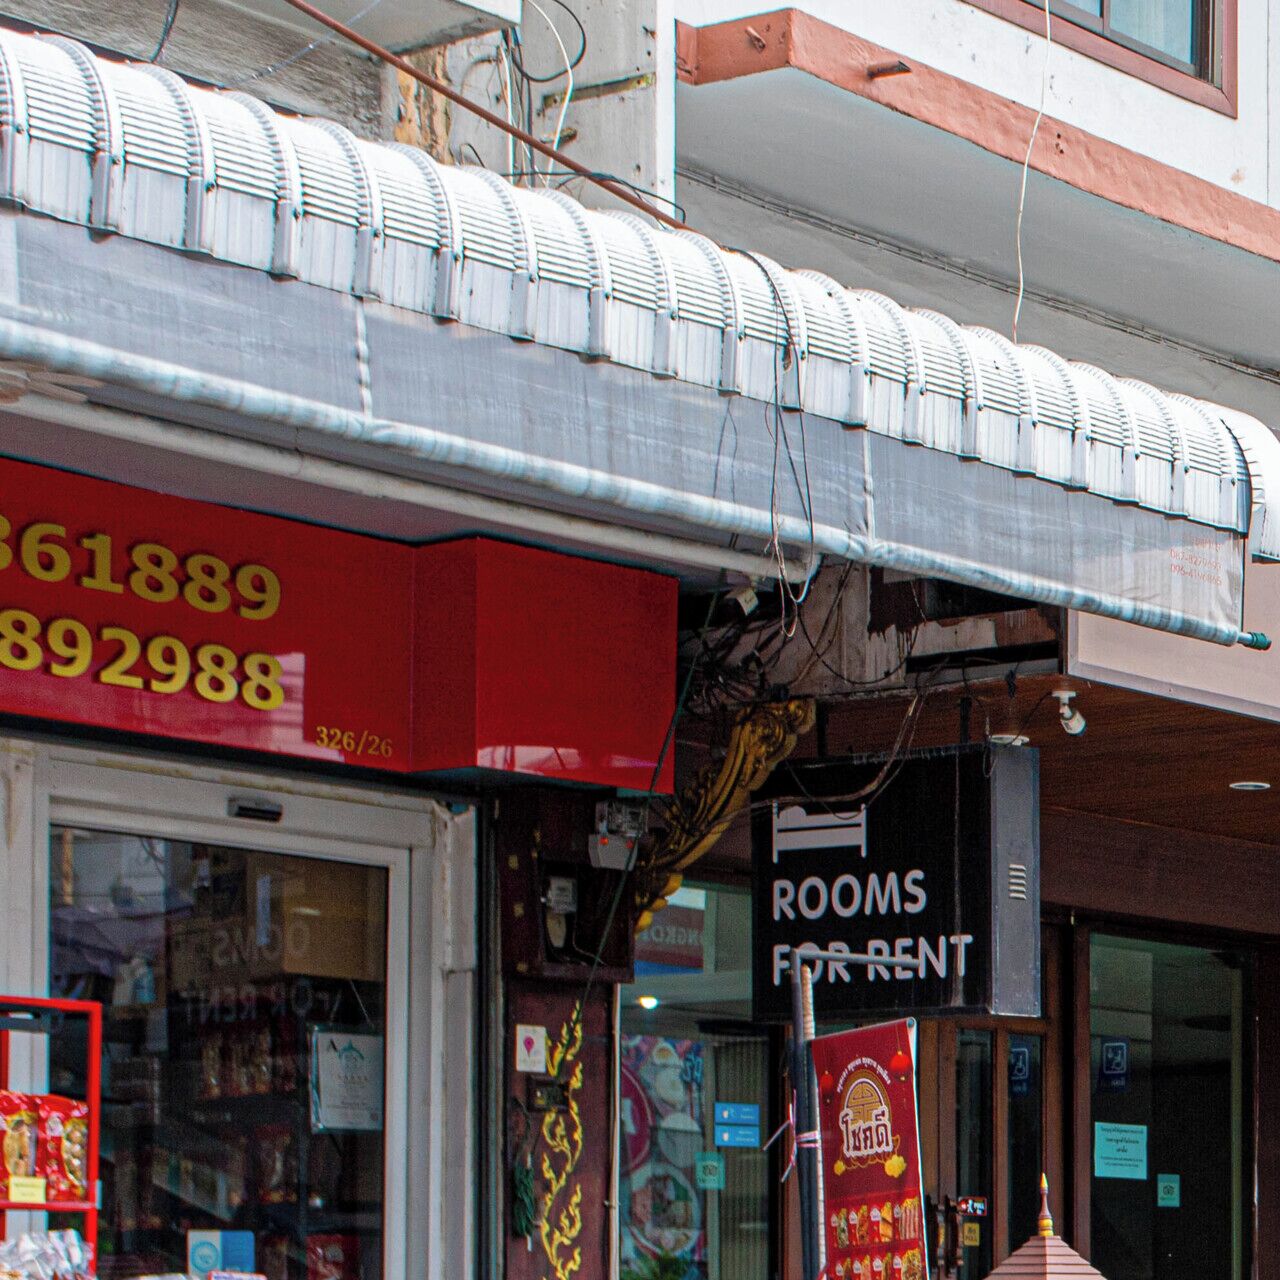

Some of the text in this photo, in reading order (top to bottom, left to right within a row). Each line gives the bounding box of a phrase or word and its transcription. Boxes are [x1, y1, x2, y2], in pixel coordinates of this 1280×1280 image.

[0, 512, 282, 621] 61889
[0, 608, 286, 712] 892988
[316, 725, 393, 759] 326/26
[773, 869, 927, 921] ROOMS
[773, 934, 974, 986] FOR RENT
[839, 1107, 893, 1157] โชคดี
